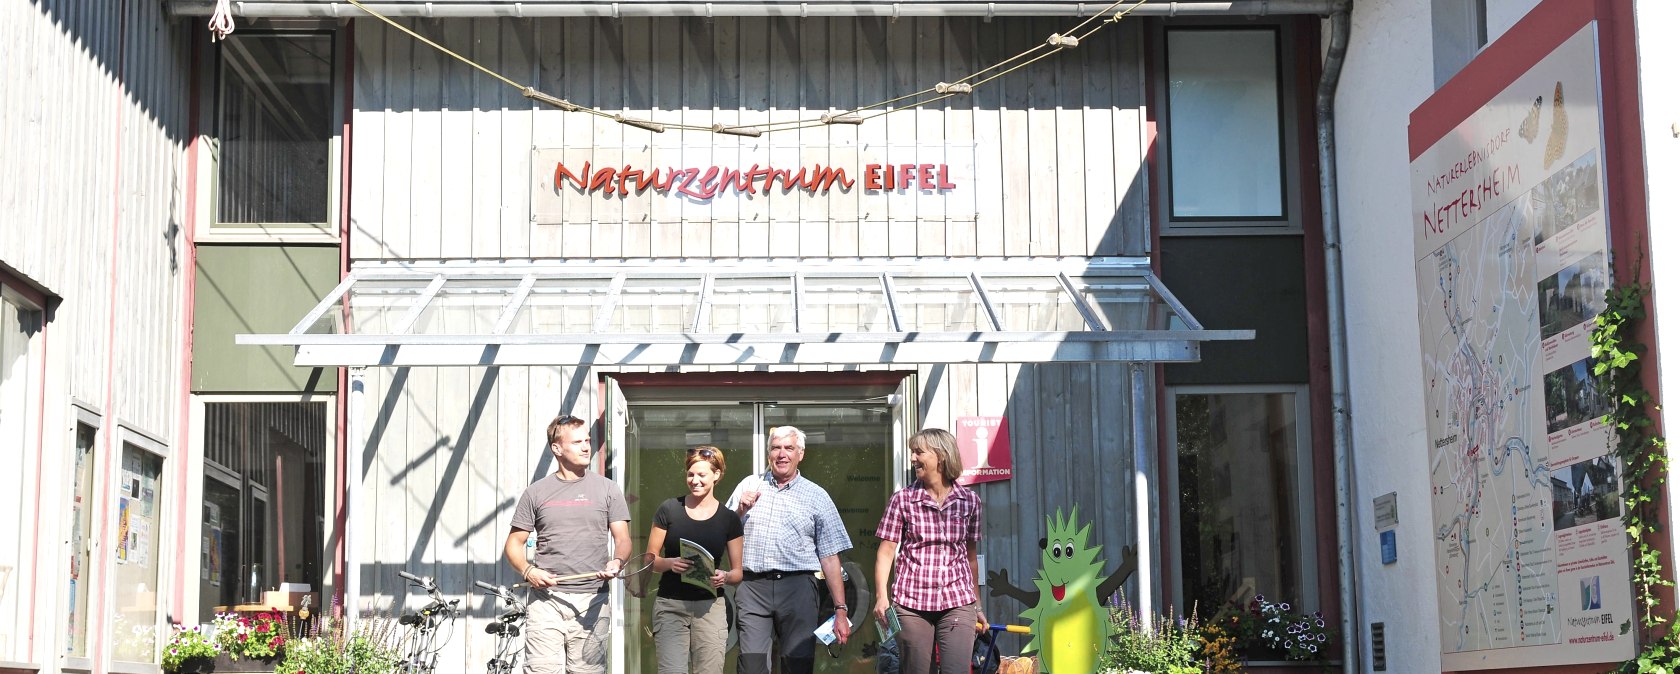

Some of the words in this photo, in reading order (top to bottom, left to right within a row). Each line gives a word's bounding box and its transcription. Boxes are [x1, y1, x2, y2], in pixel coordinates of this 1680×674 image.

[1427, 128, 1510, 196] NATURERLEBNISDORF
[554, 161, 854, 200] Naturzentrum
[865, 163, 956, 190] EIFEL
[1423, 163, 1521, 240] NETTERSHEIM
[962, 419, 1001, 427] TOURIST
[847, 474, 881, 482] Welcome
[962, 468, 1011, 477] NFORMATION
[1601, 613, 1614, 625] EIFEL
